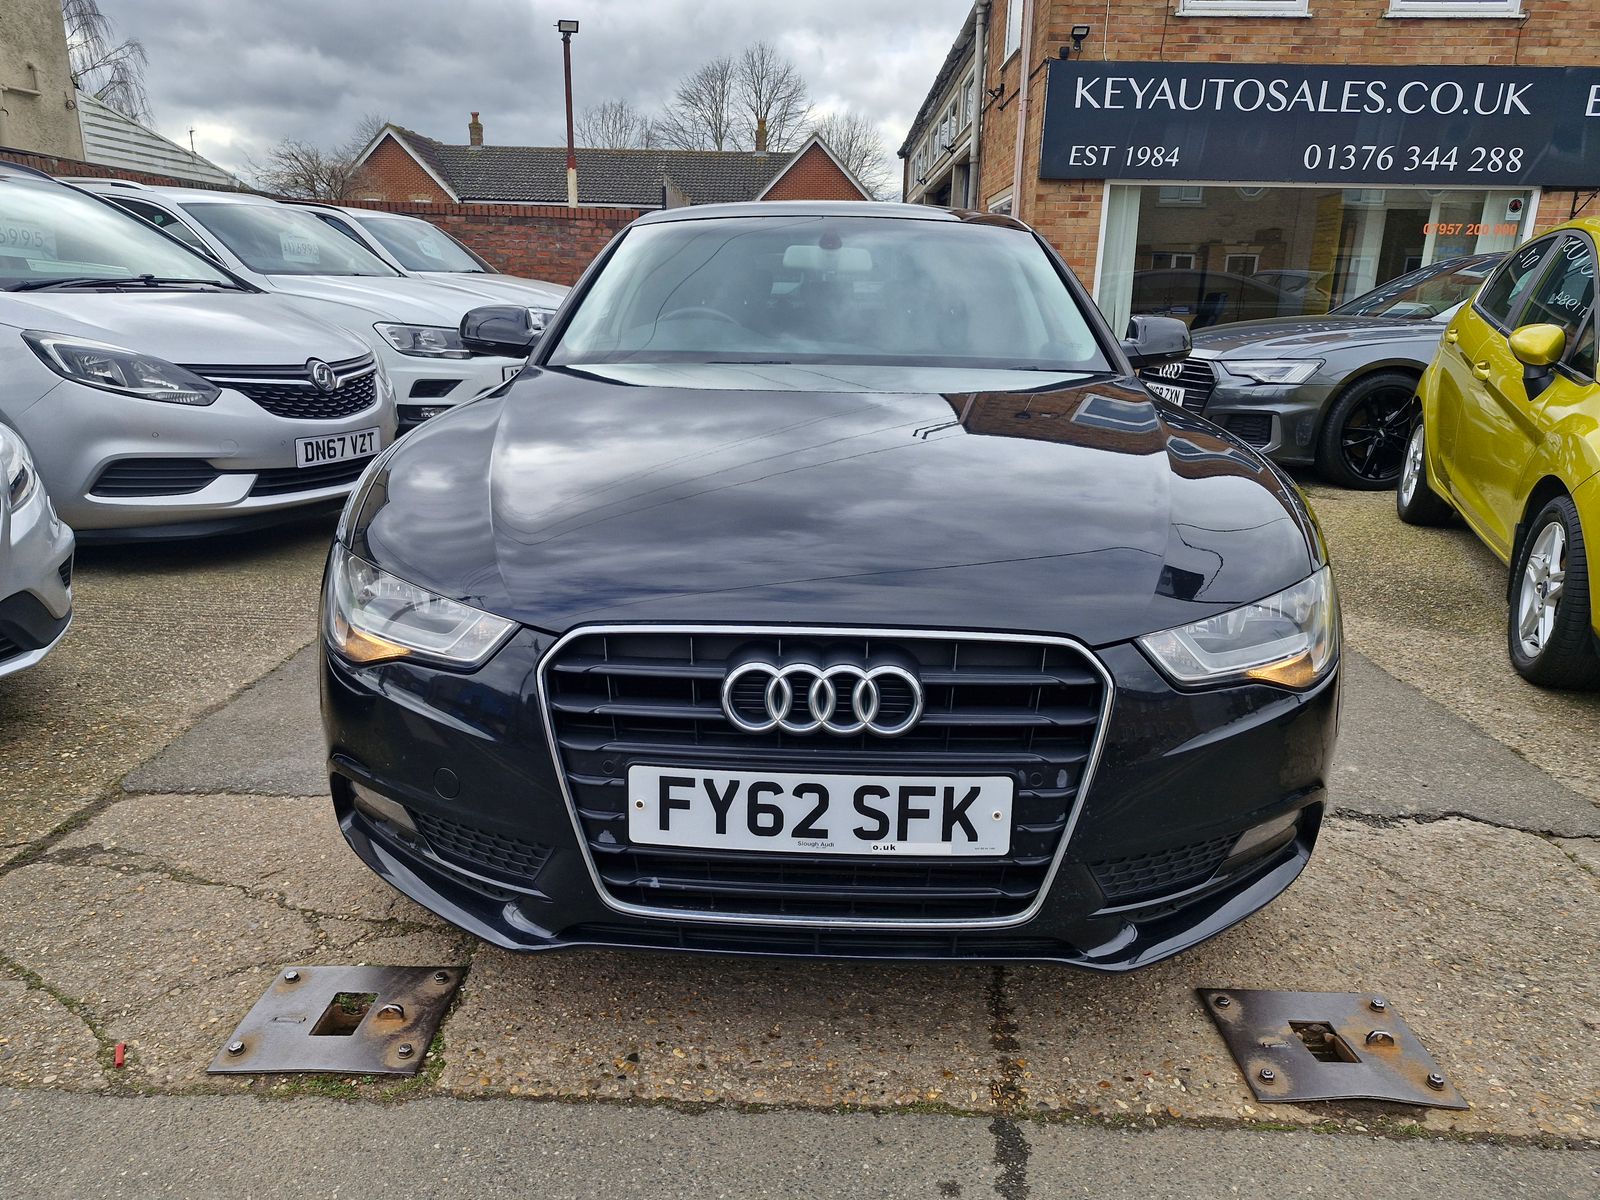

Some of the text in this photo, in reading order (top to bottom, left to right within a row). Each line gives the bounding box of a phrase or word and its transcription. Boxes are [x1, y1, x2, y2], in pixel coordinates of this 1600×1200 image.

[1074, 76, 1534, 116] KEYAUTOSALES.CO.UK
[1068, 145, 1180, 168] EST 1984
[1303, 144, 1525, 174] 01376 344 288
[1423, 223, 1464, 236] 07957
[303, 432, 375, 463] DN67 VZT
[658, 775, 982, 843] FY62 SFK
